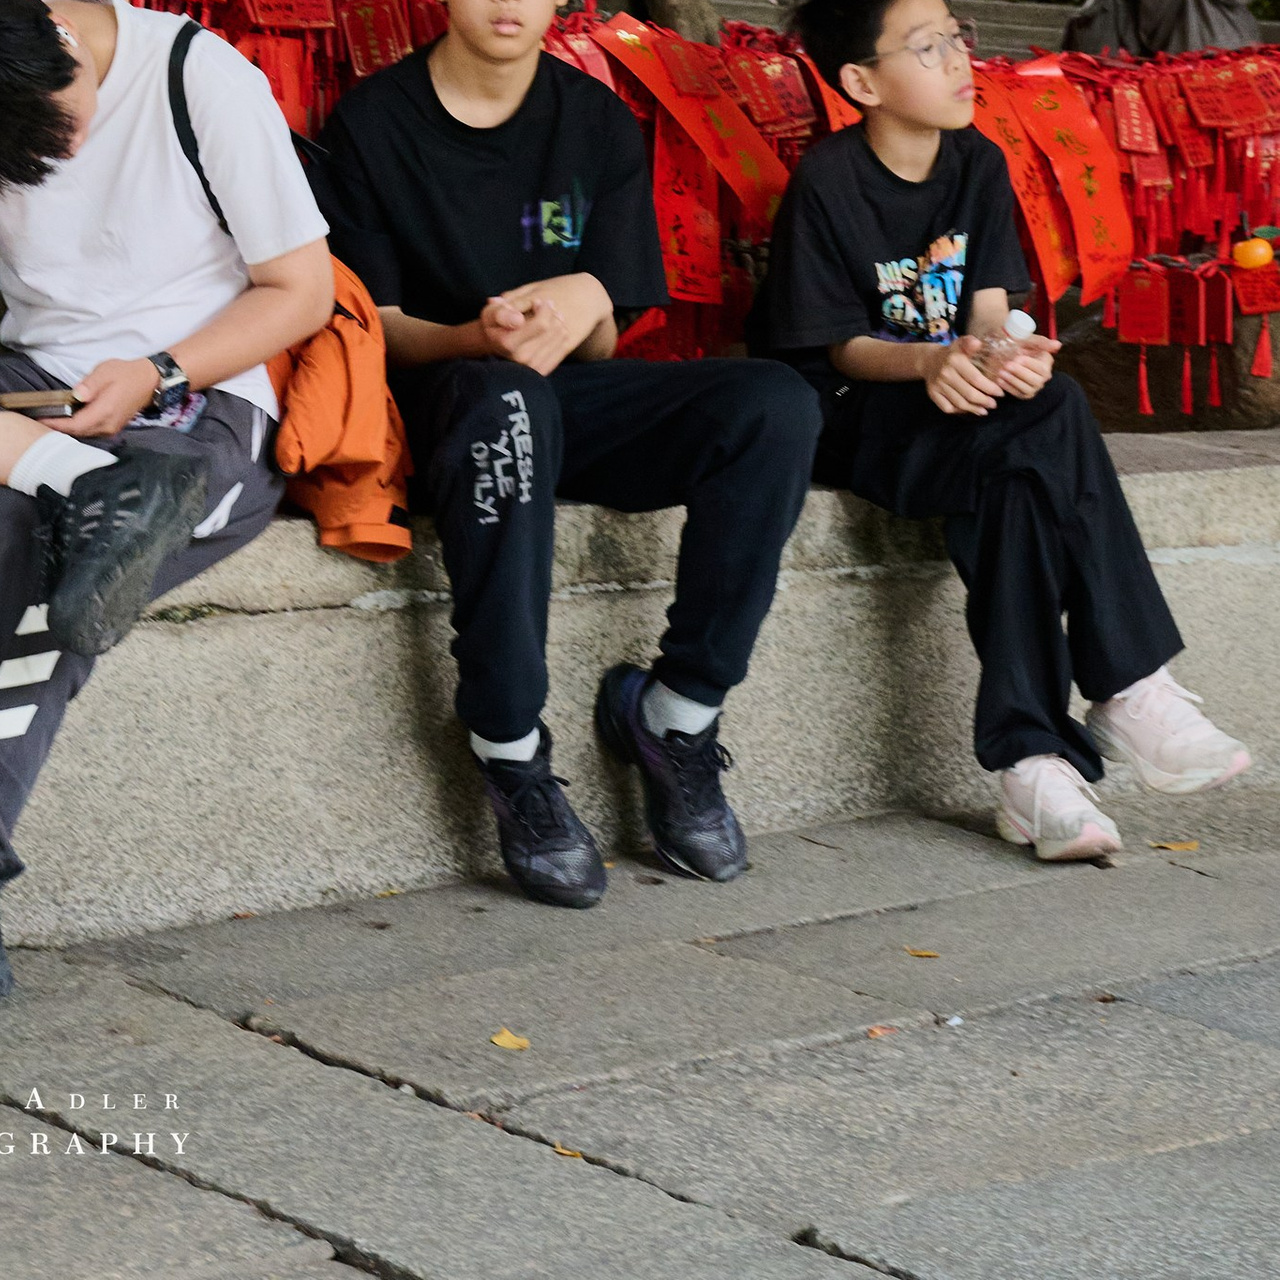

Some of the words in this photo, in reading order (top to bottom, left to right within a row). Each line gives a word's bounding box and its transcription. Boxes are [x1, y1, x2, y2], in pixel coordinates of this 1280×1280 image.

[1031, 89, 1117, 249] 心想事成
[500, 389, 534, 505] FRESH
